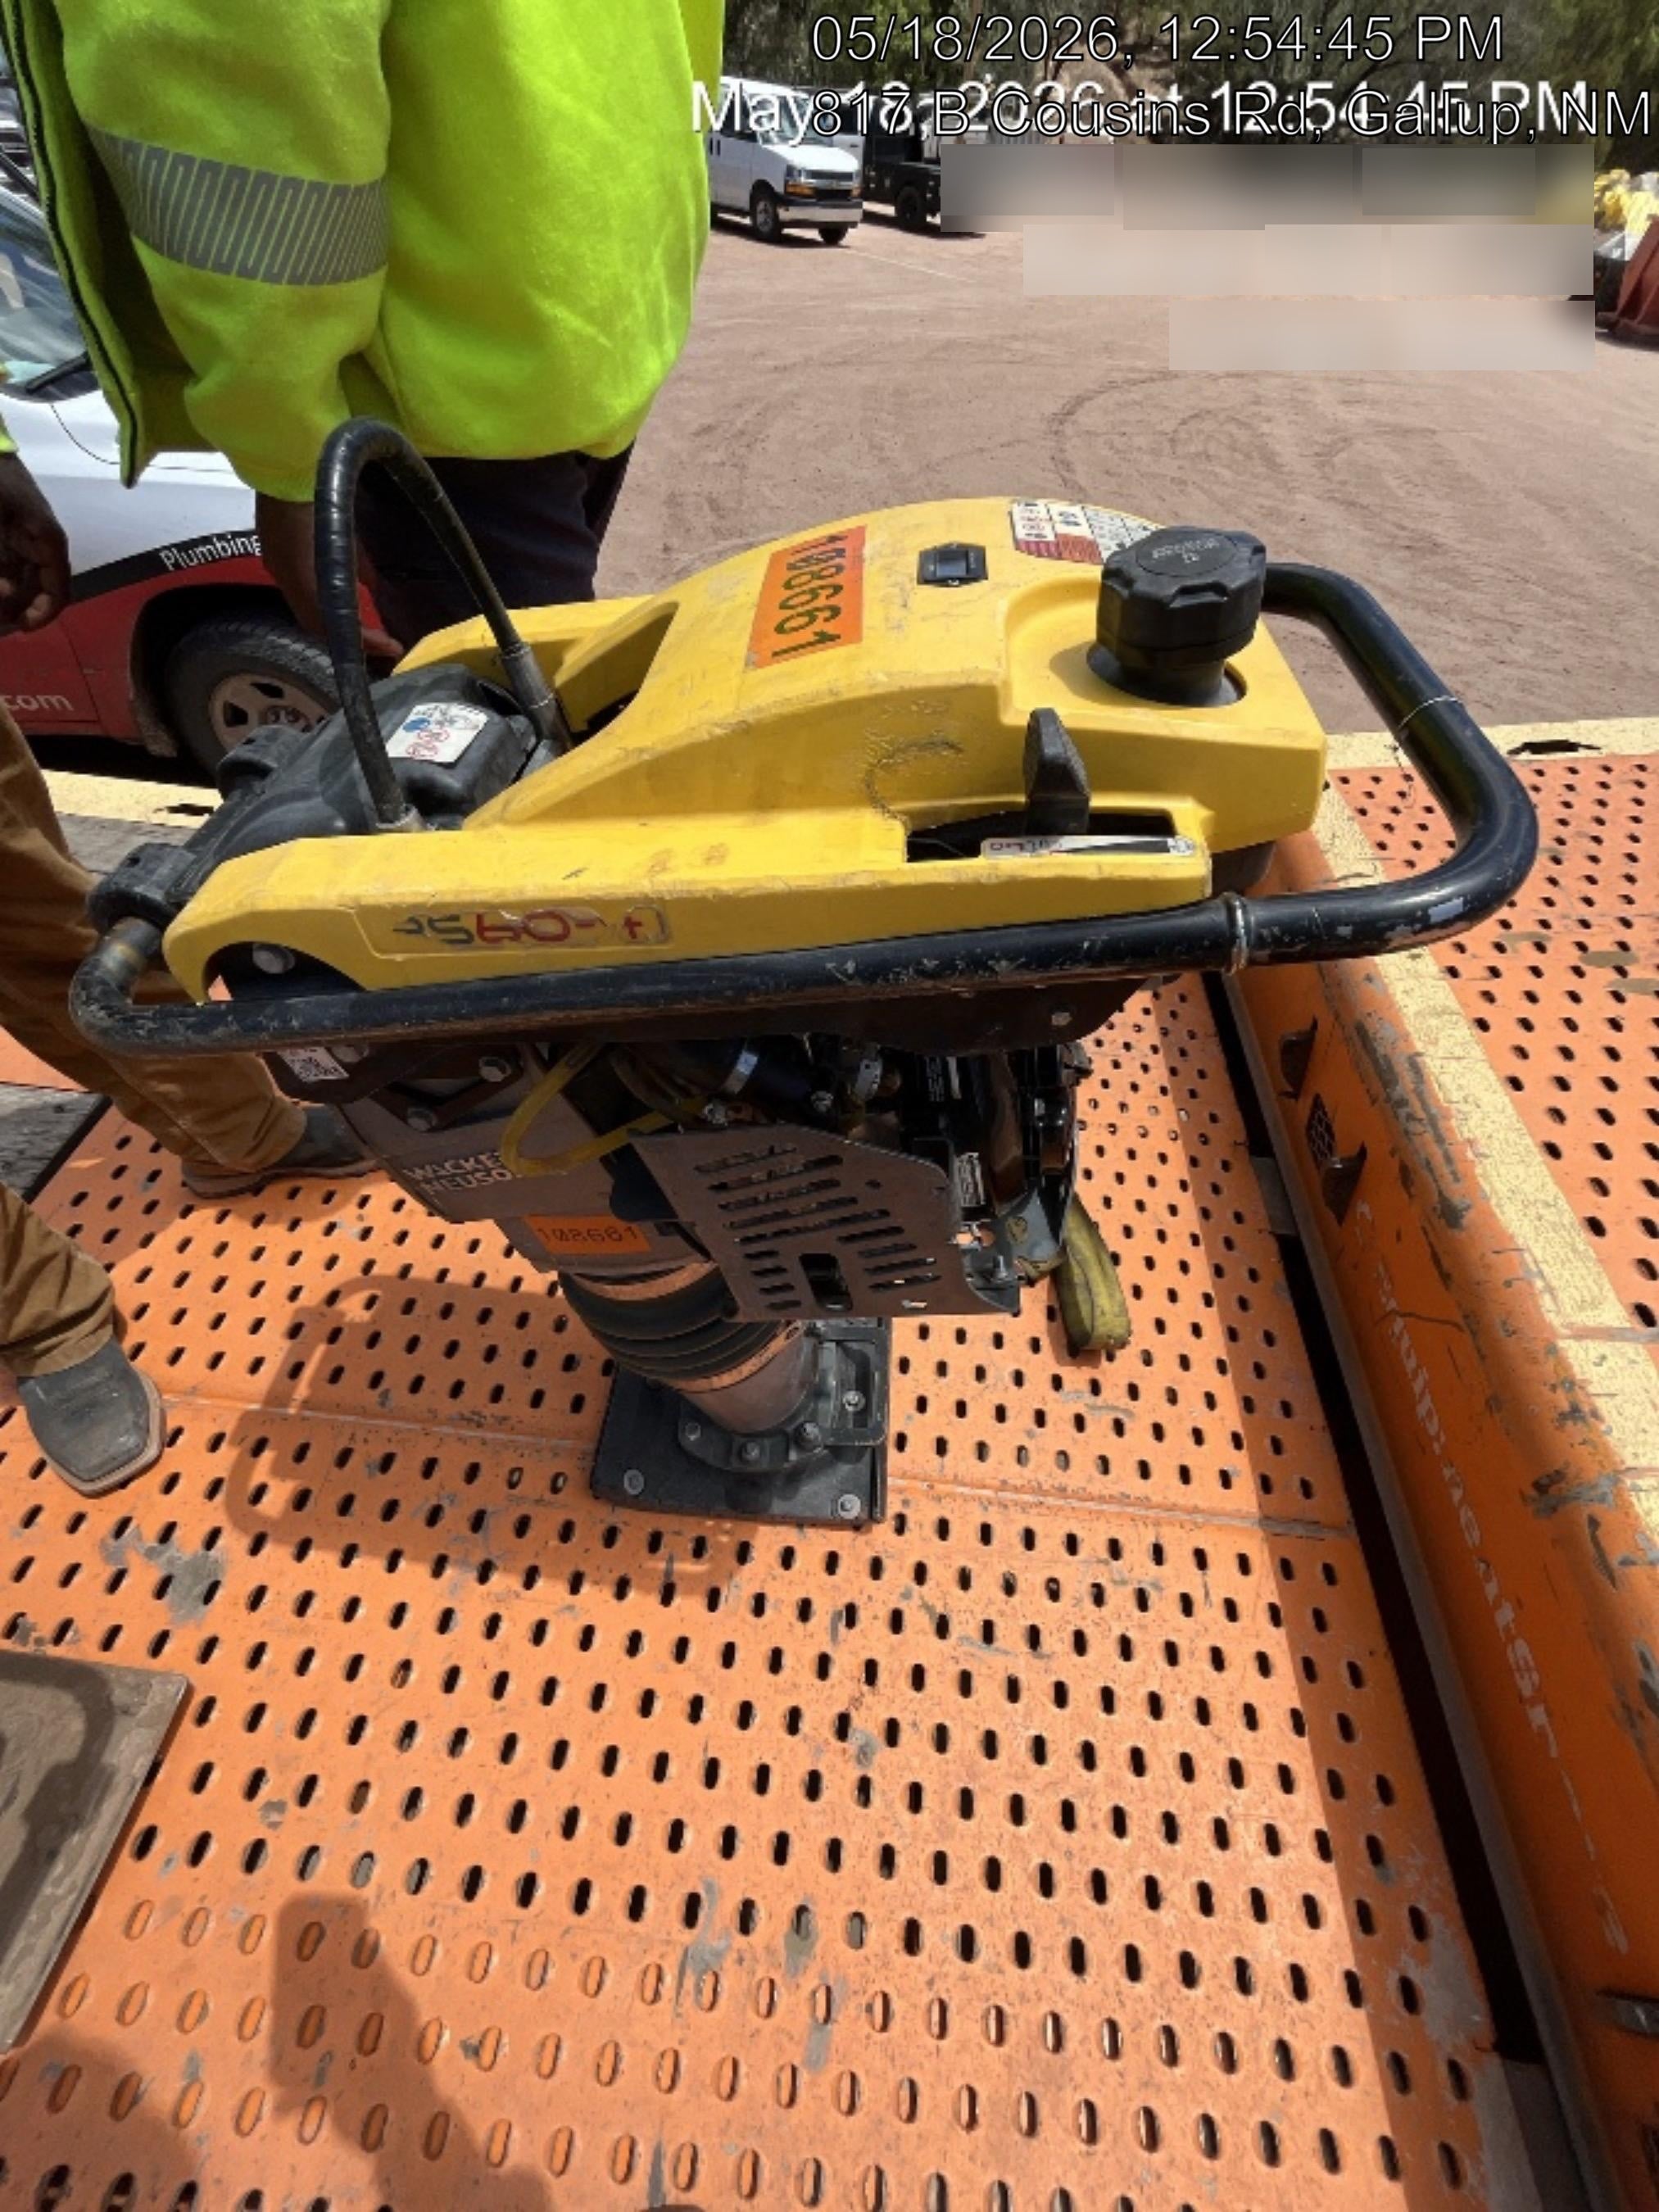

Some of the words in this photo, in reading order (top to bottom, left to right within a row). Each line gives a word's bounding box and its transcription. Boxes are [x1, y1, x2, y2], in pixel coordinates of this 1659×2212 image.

[159, 534, 261, 571] Plumbing
[403, 1151, 505, 1180] WACKE
[420, 1169, 525, 1194] NEUSO
